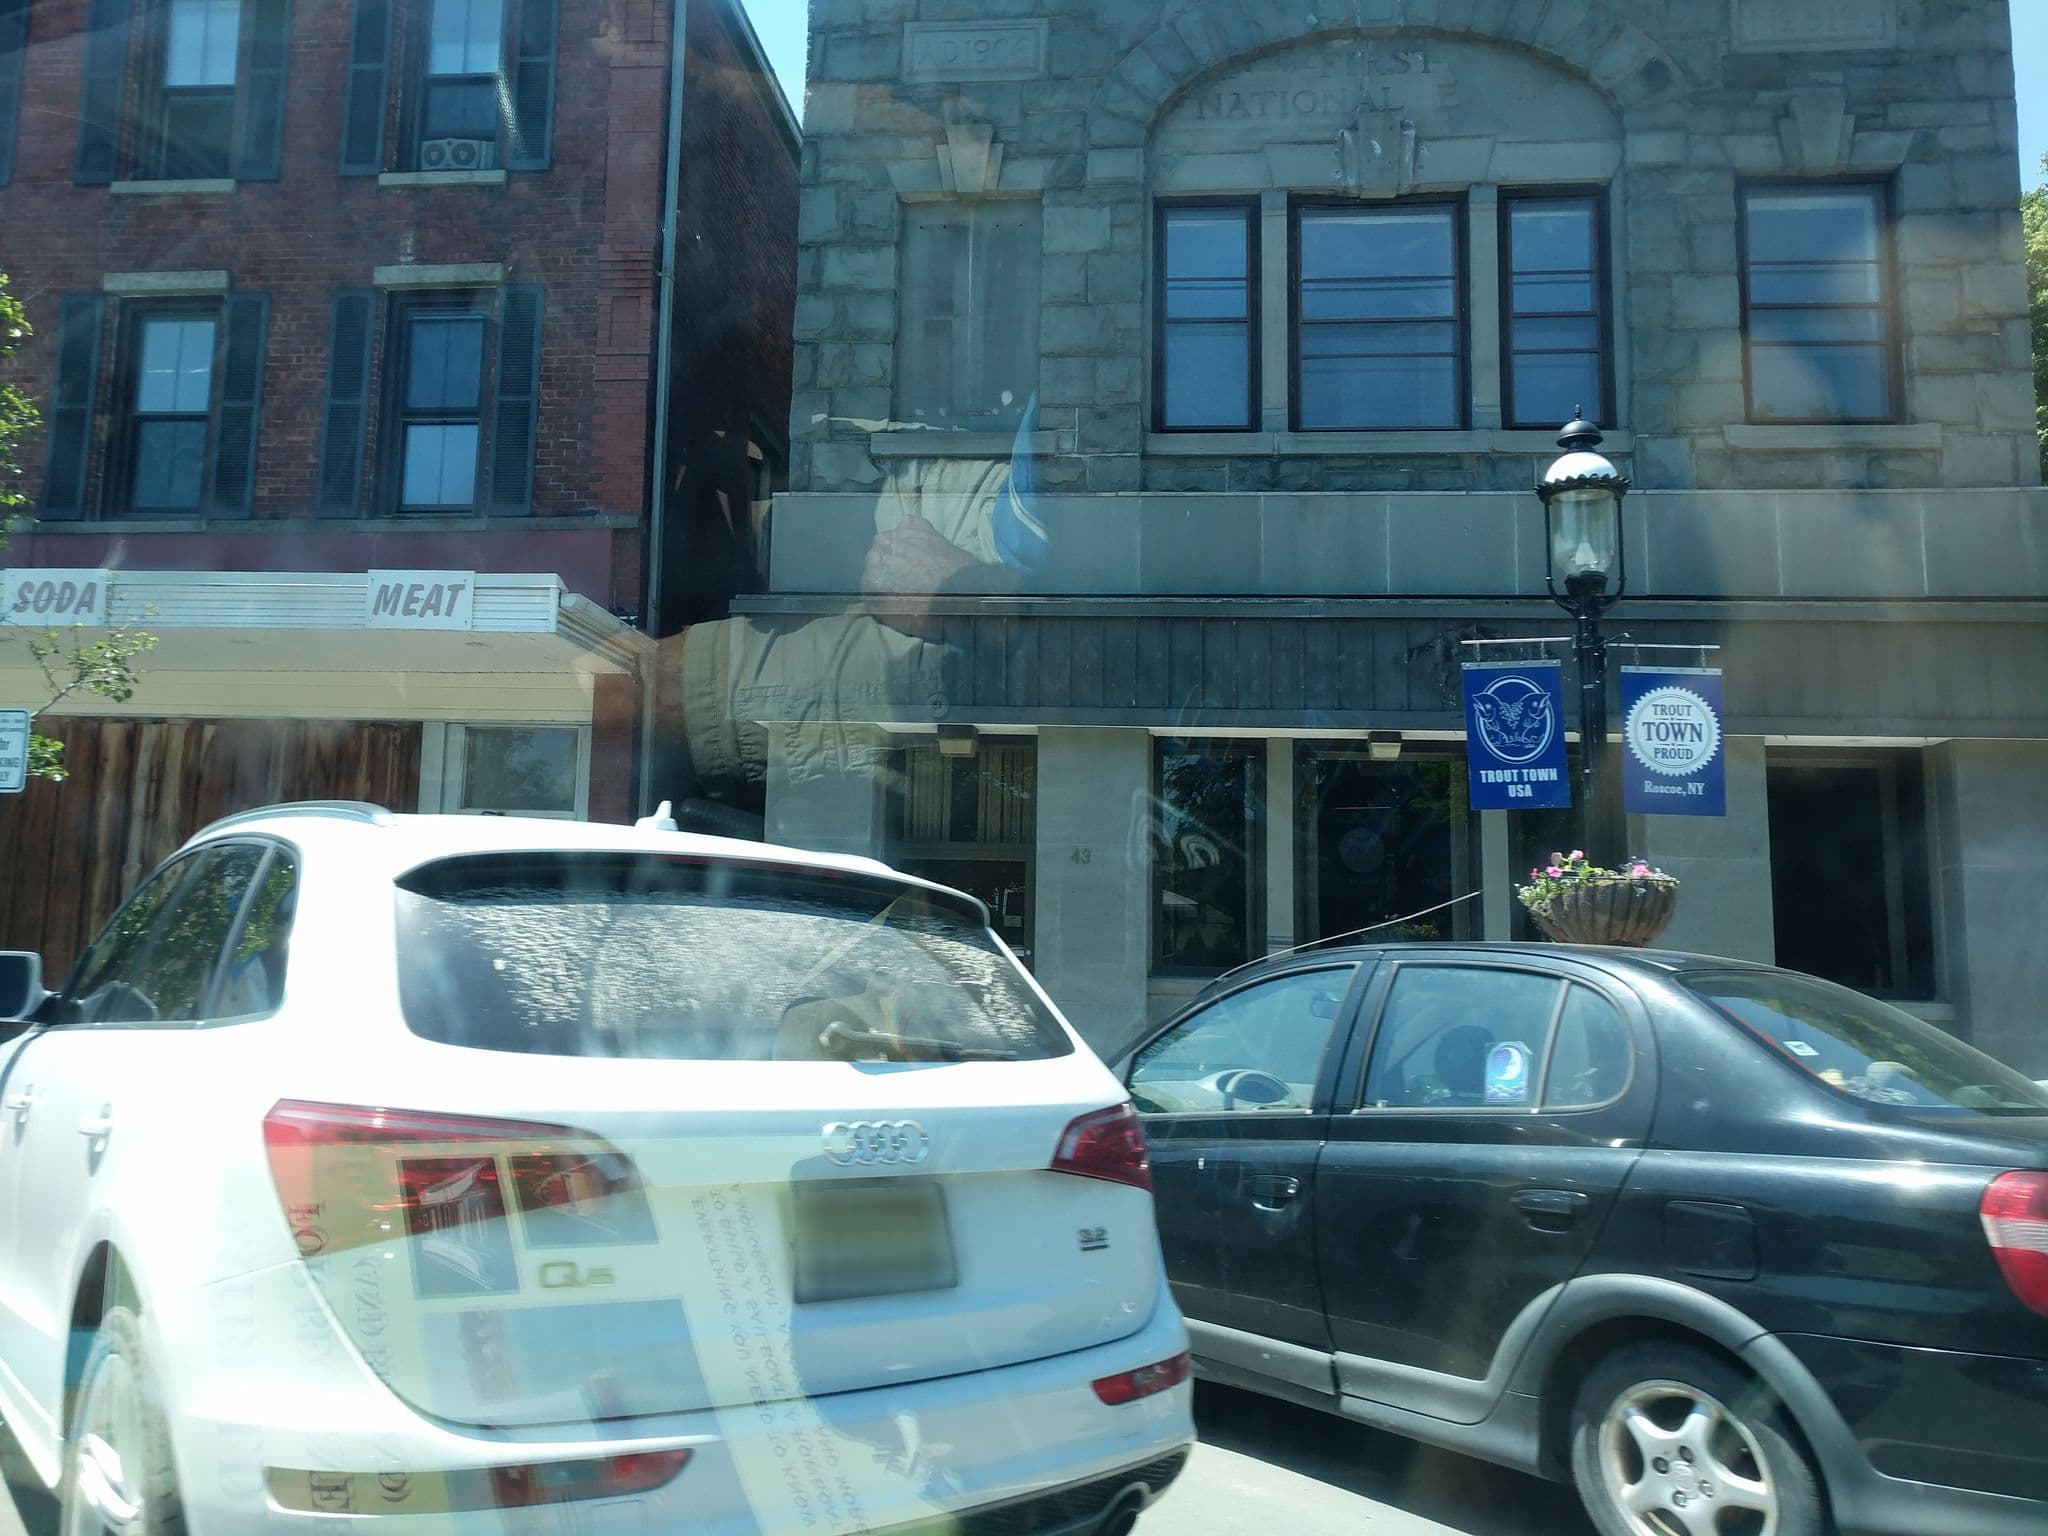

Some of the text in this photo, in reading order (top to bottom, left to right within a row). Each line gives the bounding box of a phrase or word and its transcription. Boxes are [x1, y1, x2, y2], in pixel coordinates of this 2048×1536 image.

[15, 580, 98, 615] SODA
[372, 583, 465, 618] MEAT
[1652, 704, 1693, 717] TROUT
[1642, 721, 1704, 743] TOWN
[1653, 747, 1694, 760] PROUD
[1479, 767, 1558, 784] TROUT TOWN
[1507, 784, 1534, 798] USA
[1644, 780, 1706, 797] Roscoe, NY
[1070, 847, 1093, 866] 43
